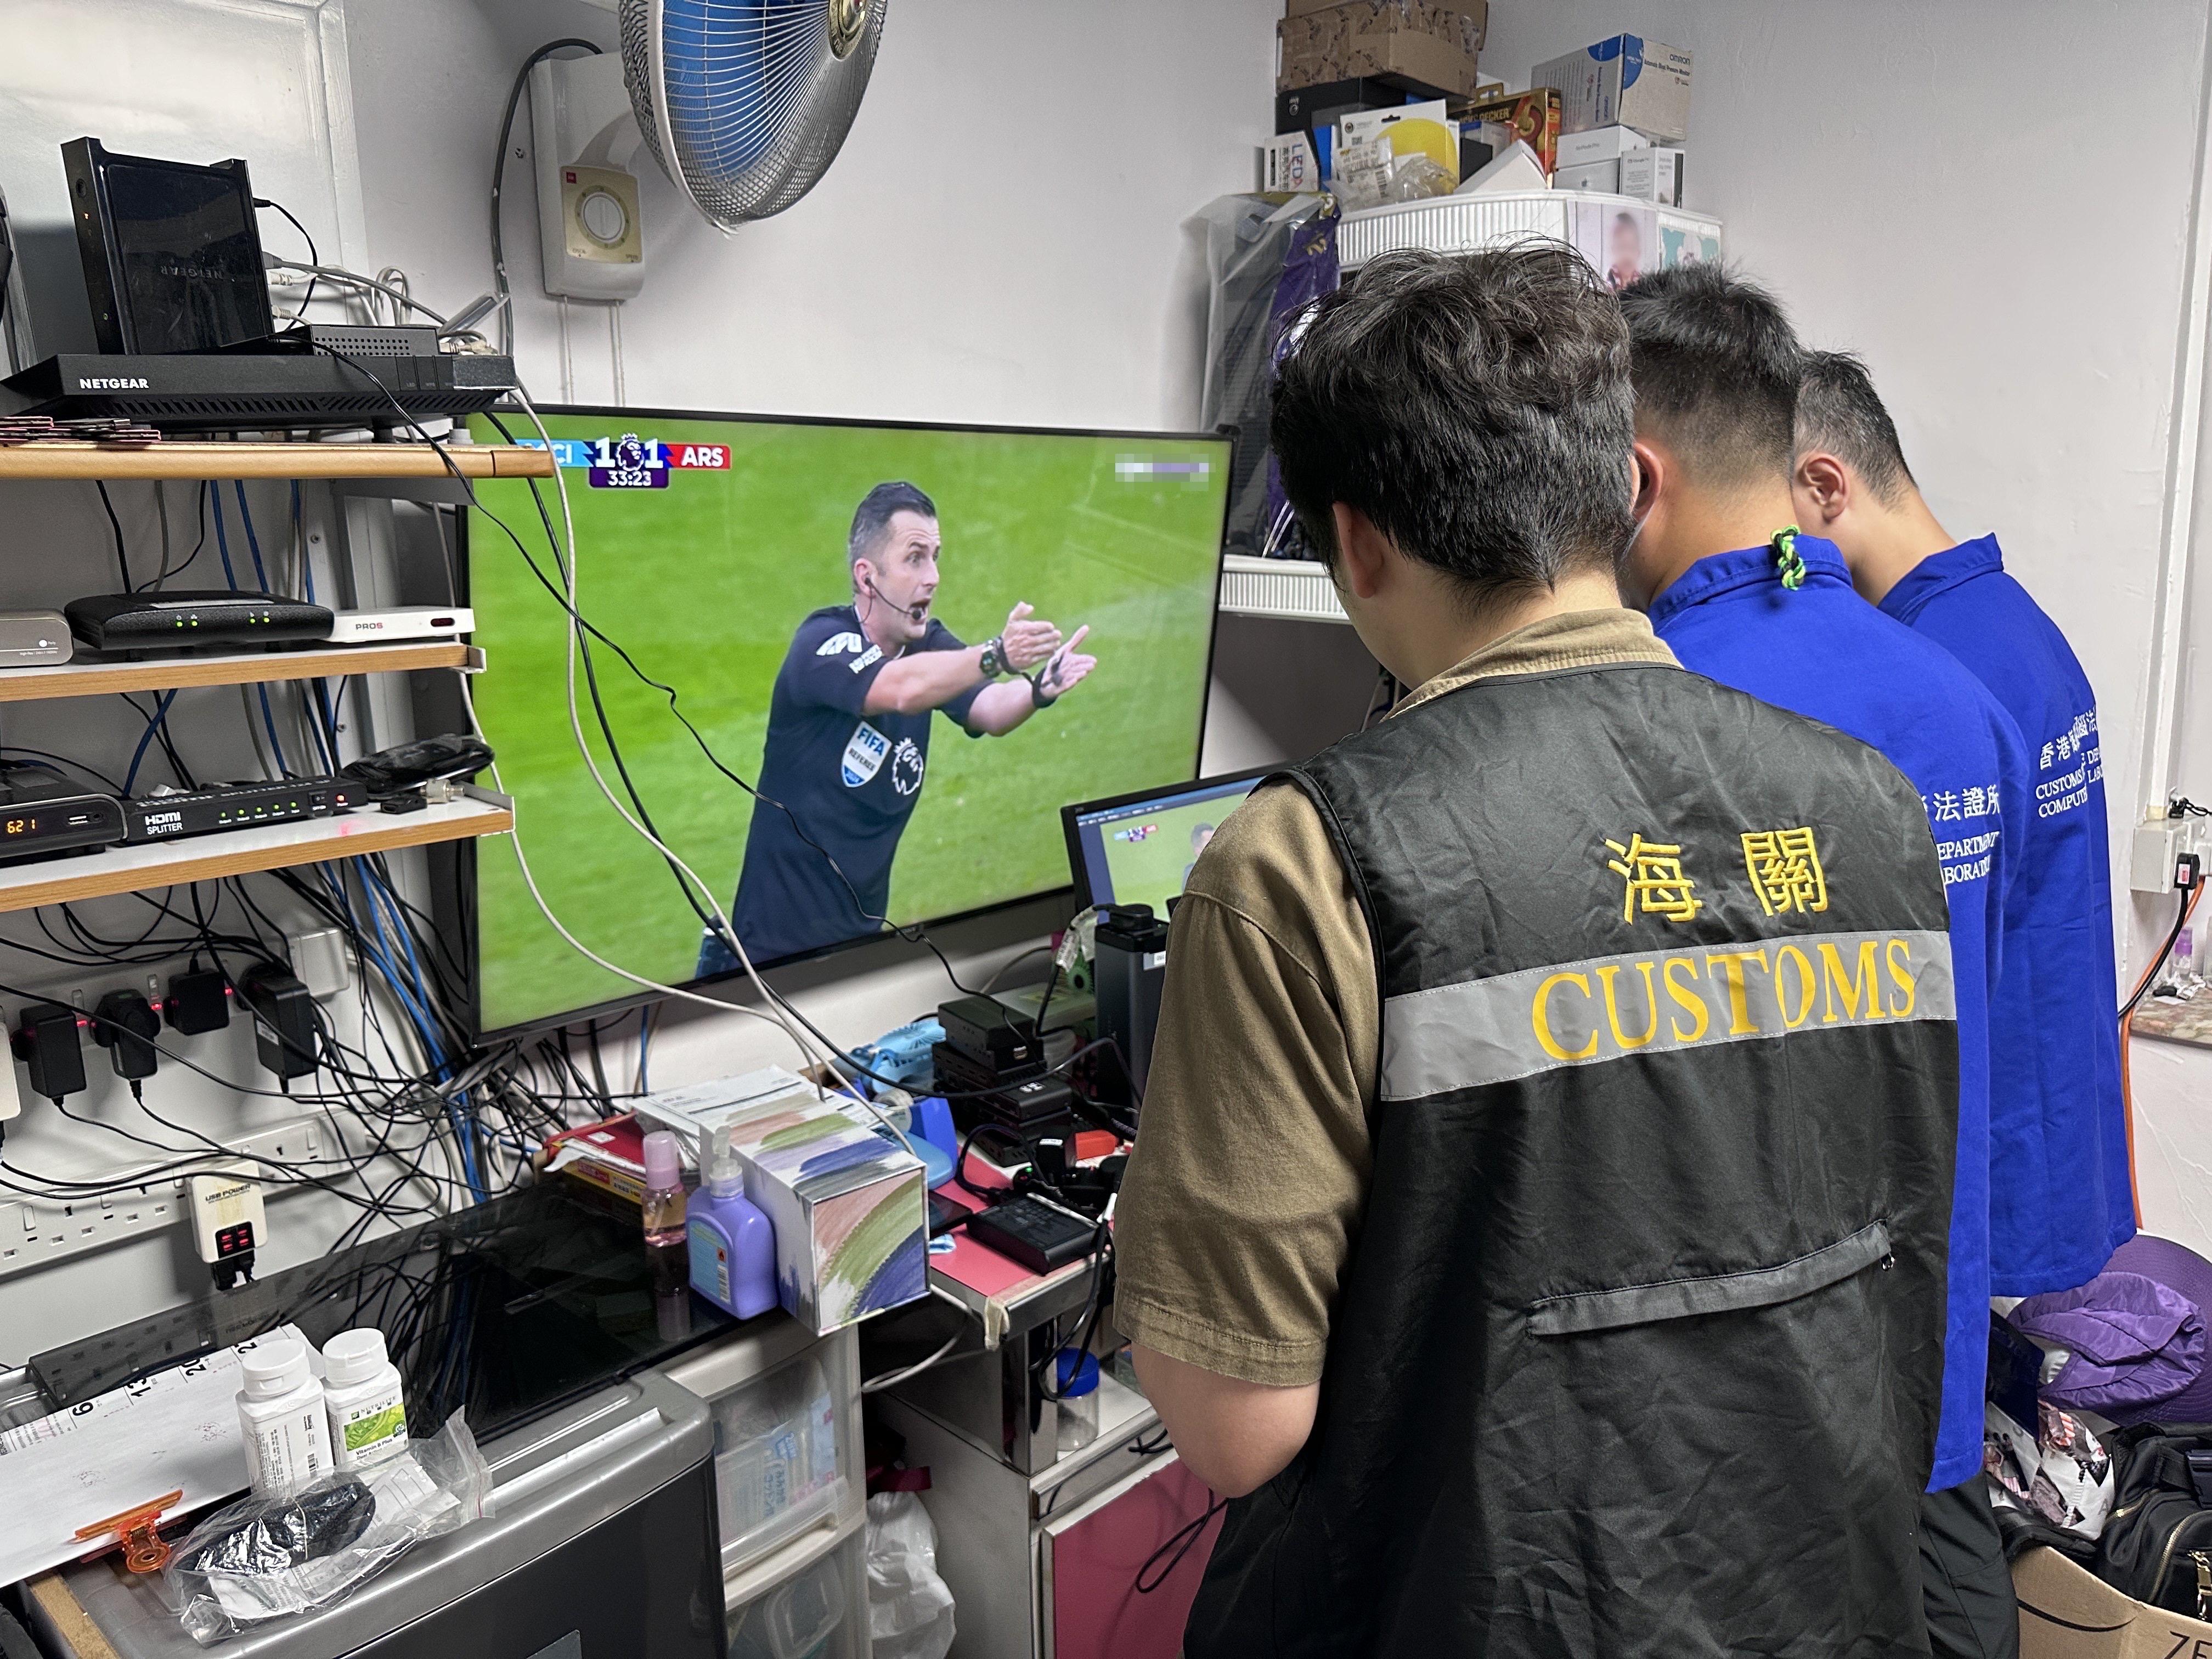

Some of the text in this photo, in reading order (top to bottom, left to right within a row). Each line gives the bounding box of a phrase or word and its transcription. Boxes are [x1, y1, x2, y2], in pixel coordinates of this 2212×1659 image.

[80, 379, 149, 389] NETGEAR
[595, 437, 616, 469] 1
[645, 439, 663, 469] 1
[681, 447, 724, 467] ARS
[608, 470, 652, 487] 33:23
[857, 727, 885, 757] FIFA
[848, 747, 877, 772] REFEREE
[2035, 747, 2100, 799] CUSTOMS DE
[1921, 784, 2000, 822] 法證所
[145, 811, 181, 826] HDMI
[146, 822, 183, 836] SPLITTER
[1532, 938, 1916, 1062] CUSTOMS
[206, 1192, 221, 1201] USB
[223, 1183, 251, 1197] POWER
[234, 1341, 258, 1354] 2
[72, 1402, 94, 1416] 6
[360, 1396, 396, 1413] NUTRILITE
[356, 1444, 376, 1455] Vitamin
